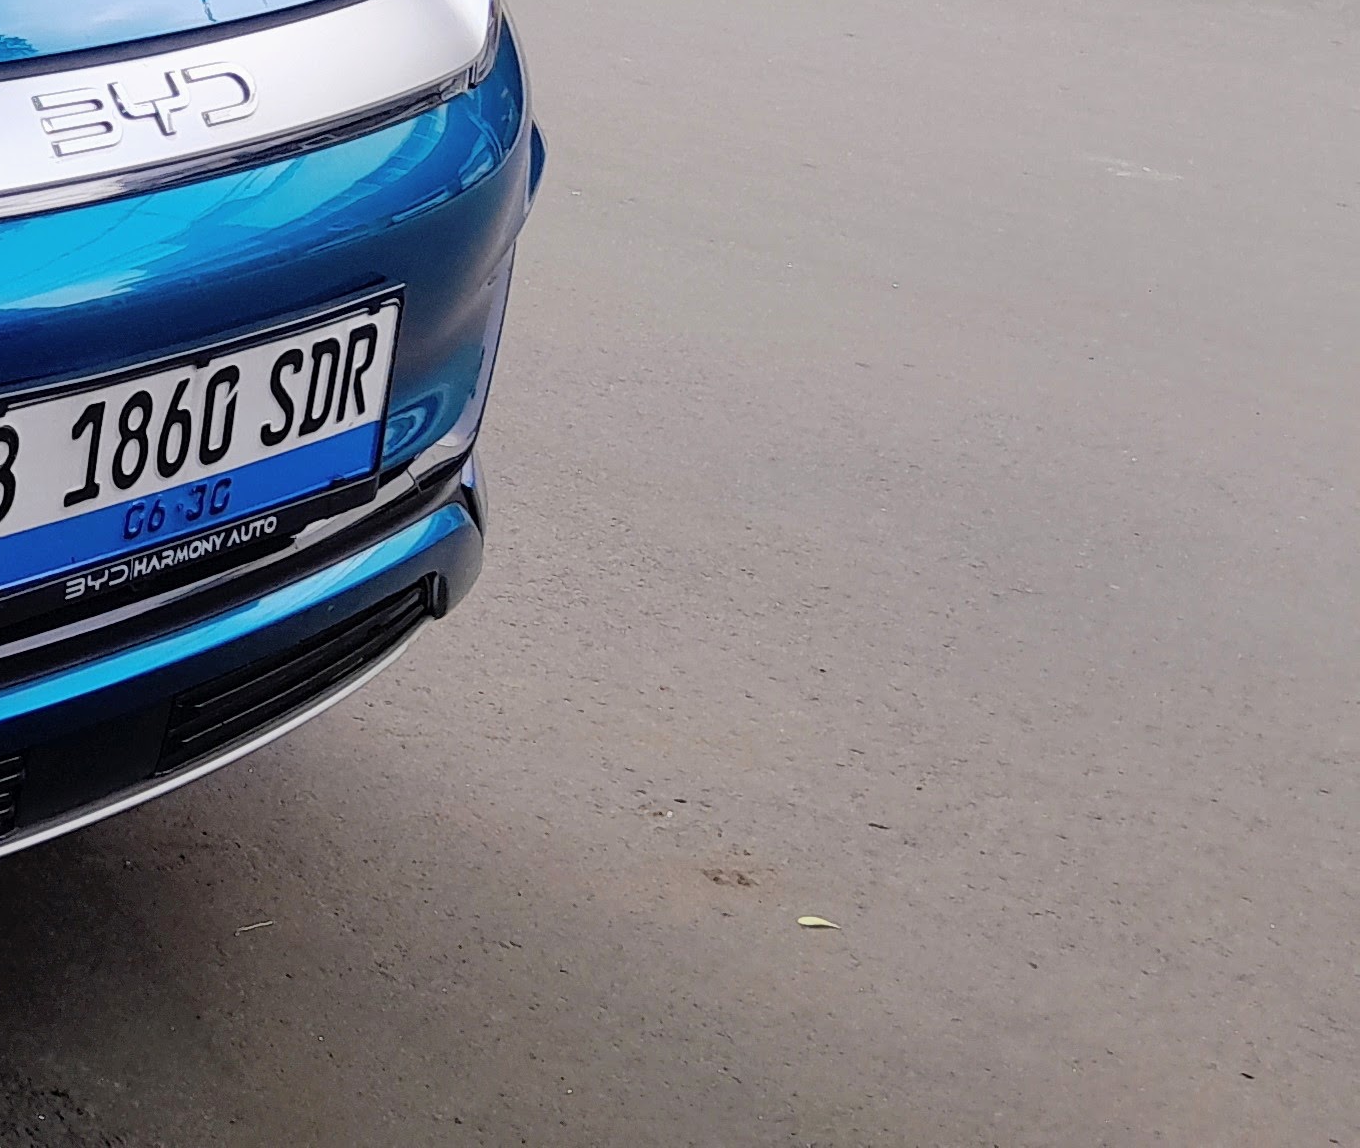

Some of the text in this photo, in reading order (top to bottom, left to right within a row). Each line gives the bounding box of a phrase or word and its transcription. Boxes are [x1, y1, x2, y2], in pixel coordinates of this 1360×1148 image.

[31, 62, 259, 158] BYD
[63, 365, 241, 508] 1860
[260, 322, 379, 448] SDR
[65, 516, 278, 600] BYD HARMONY AUTO
